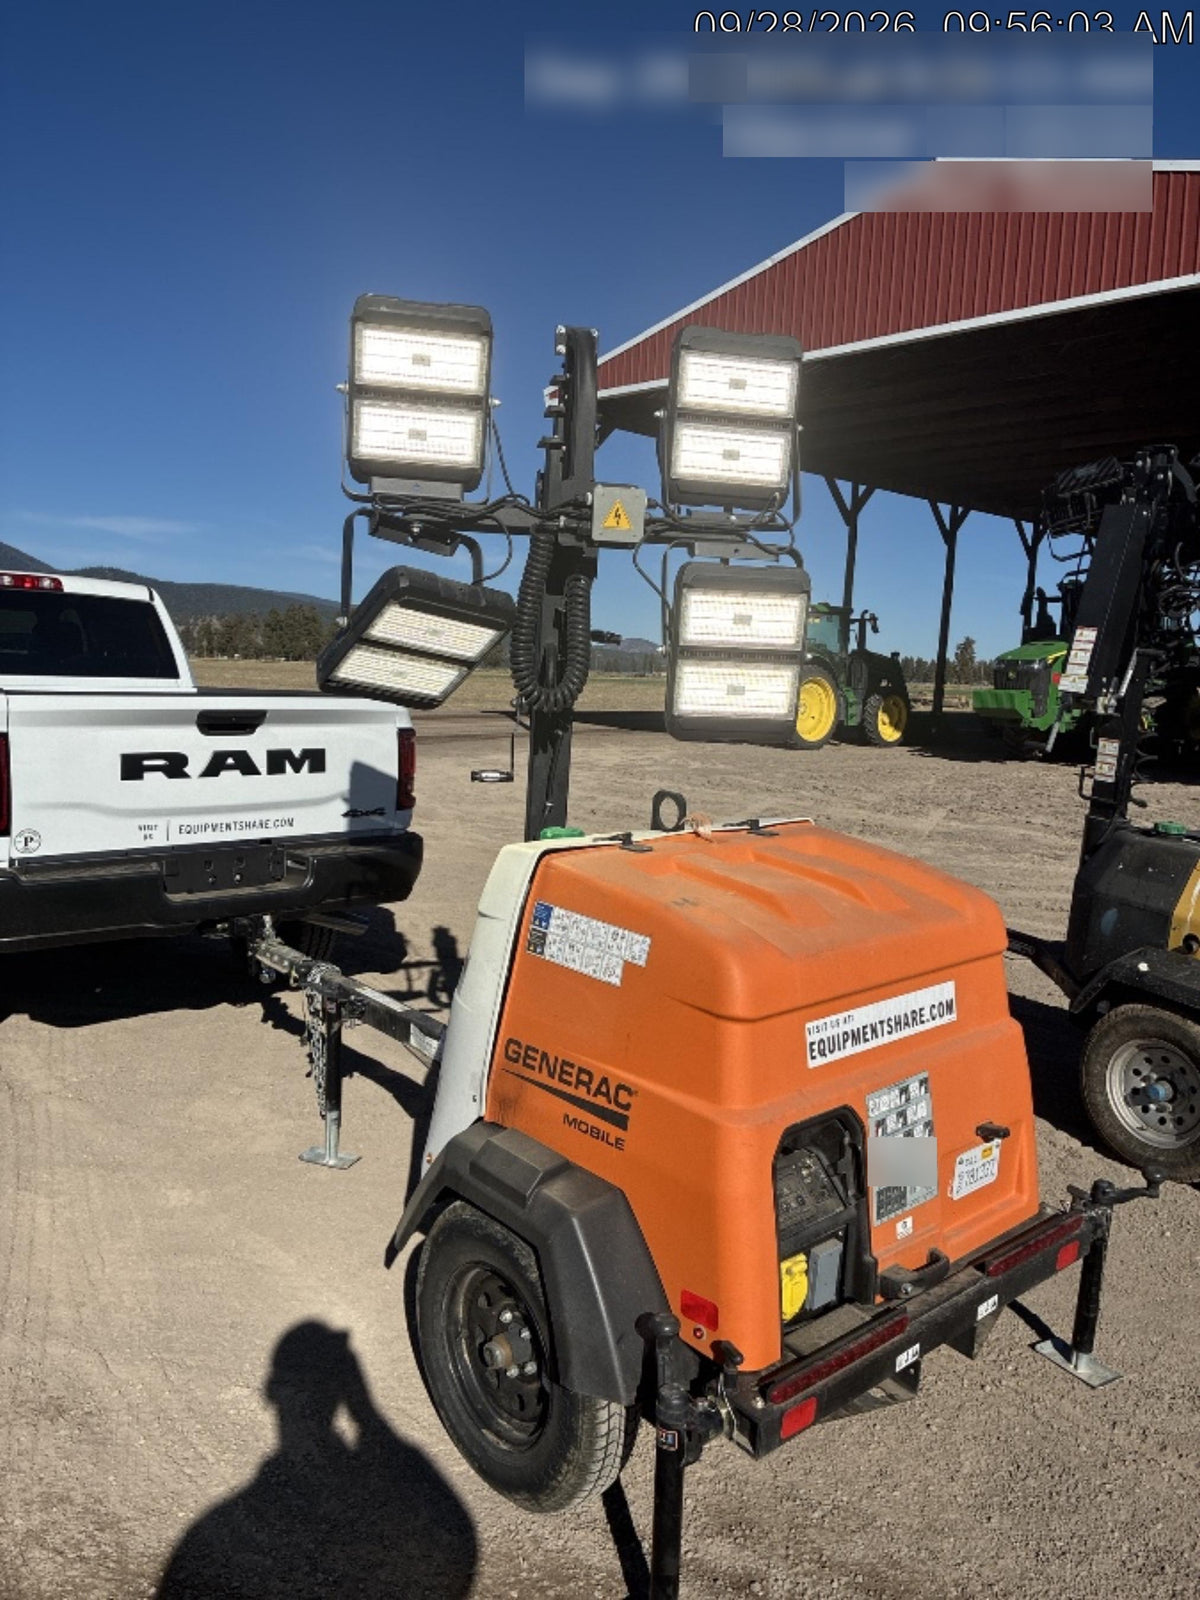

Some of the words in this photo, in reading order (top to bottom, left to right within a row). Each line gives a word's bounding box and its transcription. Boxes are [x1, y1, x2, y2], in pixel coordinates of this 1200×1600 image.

[120, 747, 326, 781] RAM
[178, 817, 294, 835] EQUIPMENTSHARE.COM
[807, 1022, 828, 1036] VISIT
[809, 998, 954, 1060] EQUIPMENTSHARE.COM
[504, 1038, 633, 1112] GENERAC
[563, 1113, 625, 1150] MOBILE
